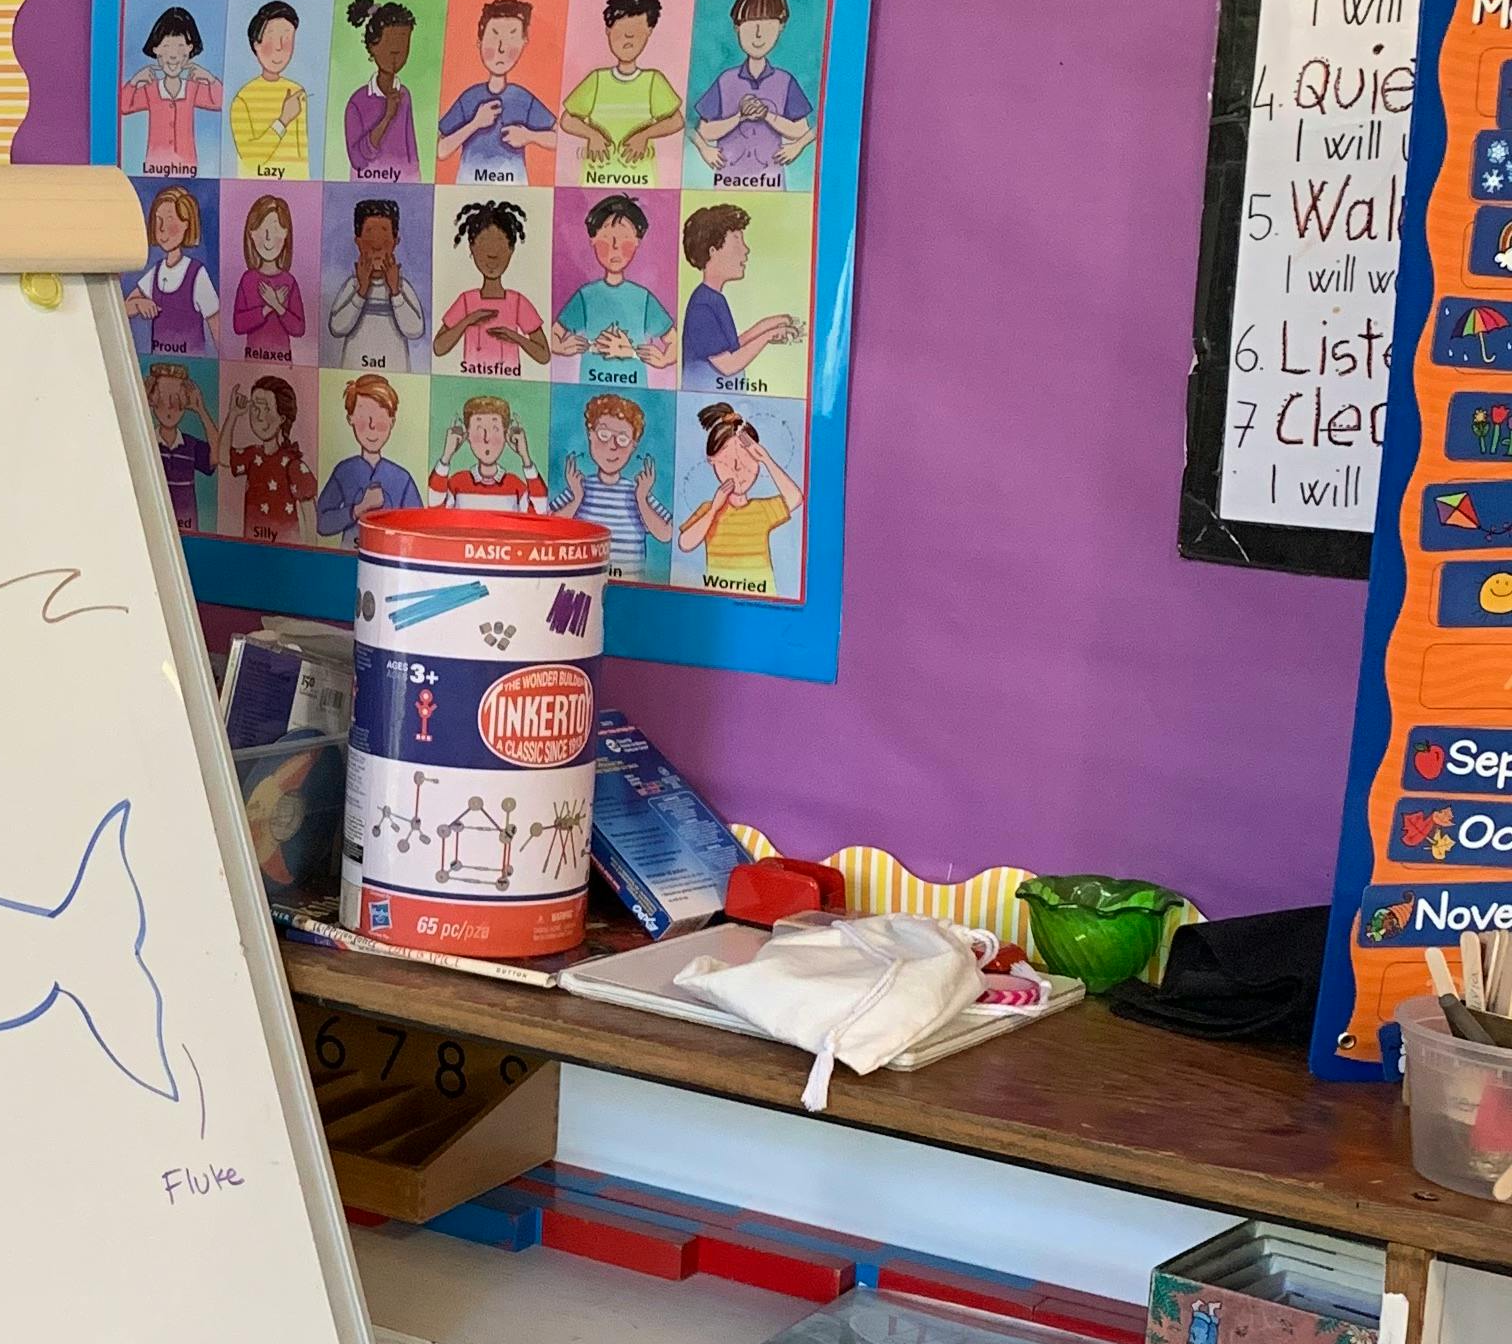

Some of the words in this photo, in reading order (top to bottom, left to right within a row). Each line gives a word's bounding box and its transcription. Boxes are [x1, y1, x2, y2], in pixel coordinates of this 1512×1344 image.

[1253, 64, 1284, 123] 4.
[1294, 44, 1416, 115] Quie
[1296, 119, 1303, 161] I
[1324, 120, 1383, 161] will
[142, 163, 198, 177] Laughing
[257, 164, 285, 179] Lazy
[357, 167, 401, 182] Lonely
[474, 169, 514, 183] Mean
[586, 172, 649, 185] Nervous
[713, 173, 781, 188] Peaceful
[1248, 194, 1279, 241] 5.
[1291, 175, 1407, 242] Wal
[1286, 255, 1292, 293] I
[1309, 255, 1356, 294] will
[151, 340, 187, 354] Proud
[245, 347, 292, 362] Relaxed
[1235, 325, 1264, 372] 6.
[361, 355, 386, 368] Sad
[460, 360, 522, 378] Satisfied
[589, 368, 638, 386] Scared
[716, 377, 769, 394] Selfish
[1233, 400, 1257, 448] 7
[1270, 465, 1277, 504] I
[1301, 466, 1359, 507] will
[253, 526, 278, 541] Silly
[464, 544, 511, 561] BASIC
[528, 548, 555, 561] ALL
[558, 545, 588, 560] REAL
[703, 575, 767, 595] Worried
[387, 660, 408, 671] AGES
[410, 663, 438, 685] 3+
[504, 678, 521, 691] THE
[522, 671, 558, 689] WONDER
[496, 739, 503, 752] A
[505, 739, 543, 763] CLASSIC
[545, 739, 568, 762] SINCE
[1415, 890, 1512, 931] Nove
[417, 916, 439, 935] 65
[315, 1015, 346, 1070] 6
[377, 1025, 407, 1081] 7
[435, 1040, 467, 1098] 8
[161, 1164, 246, 1204] Fluke
